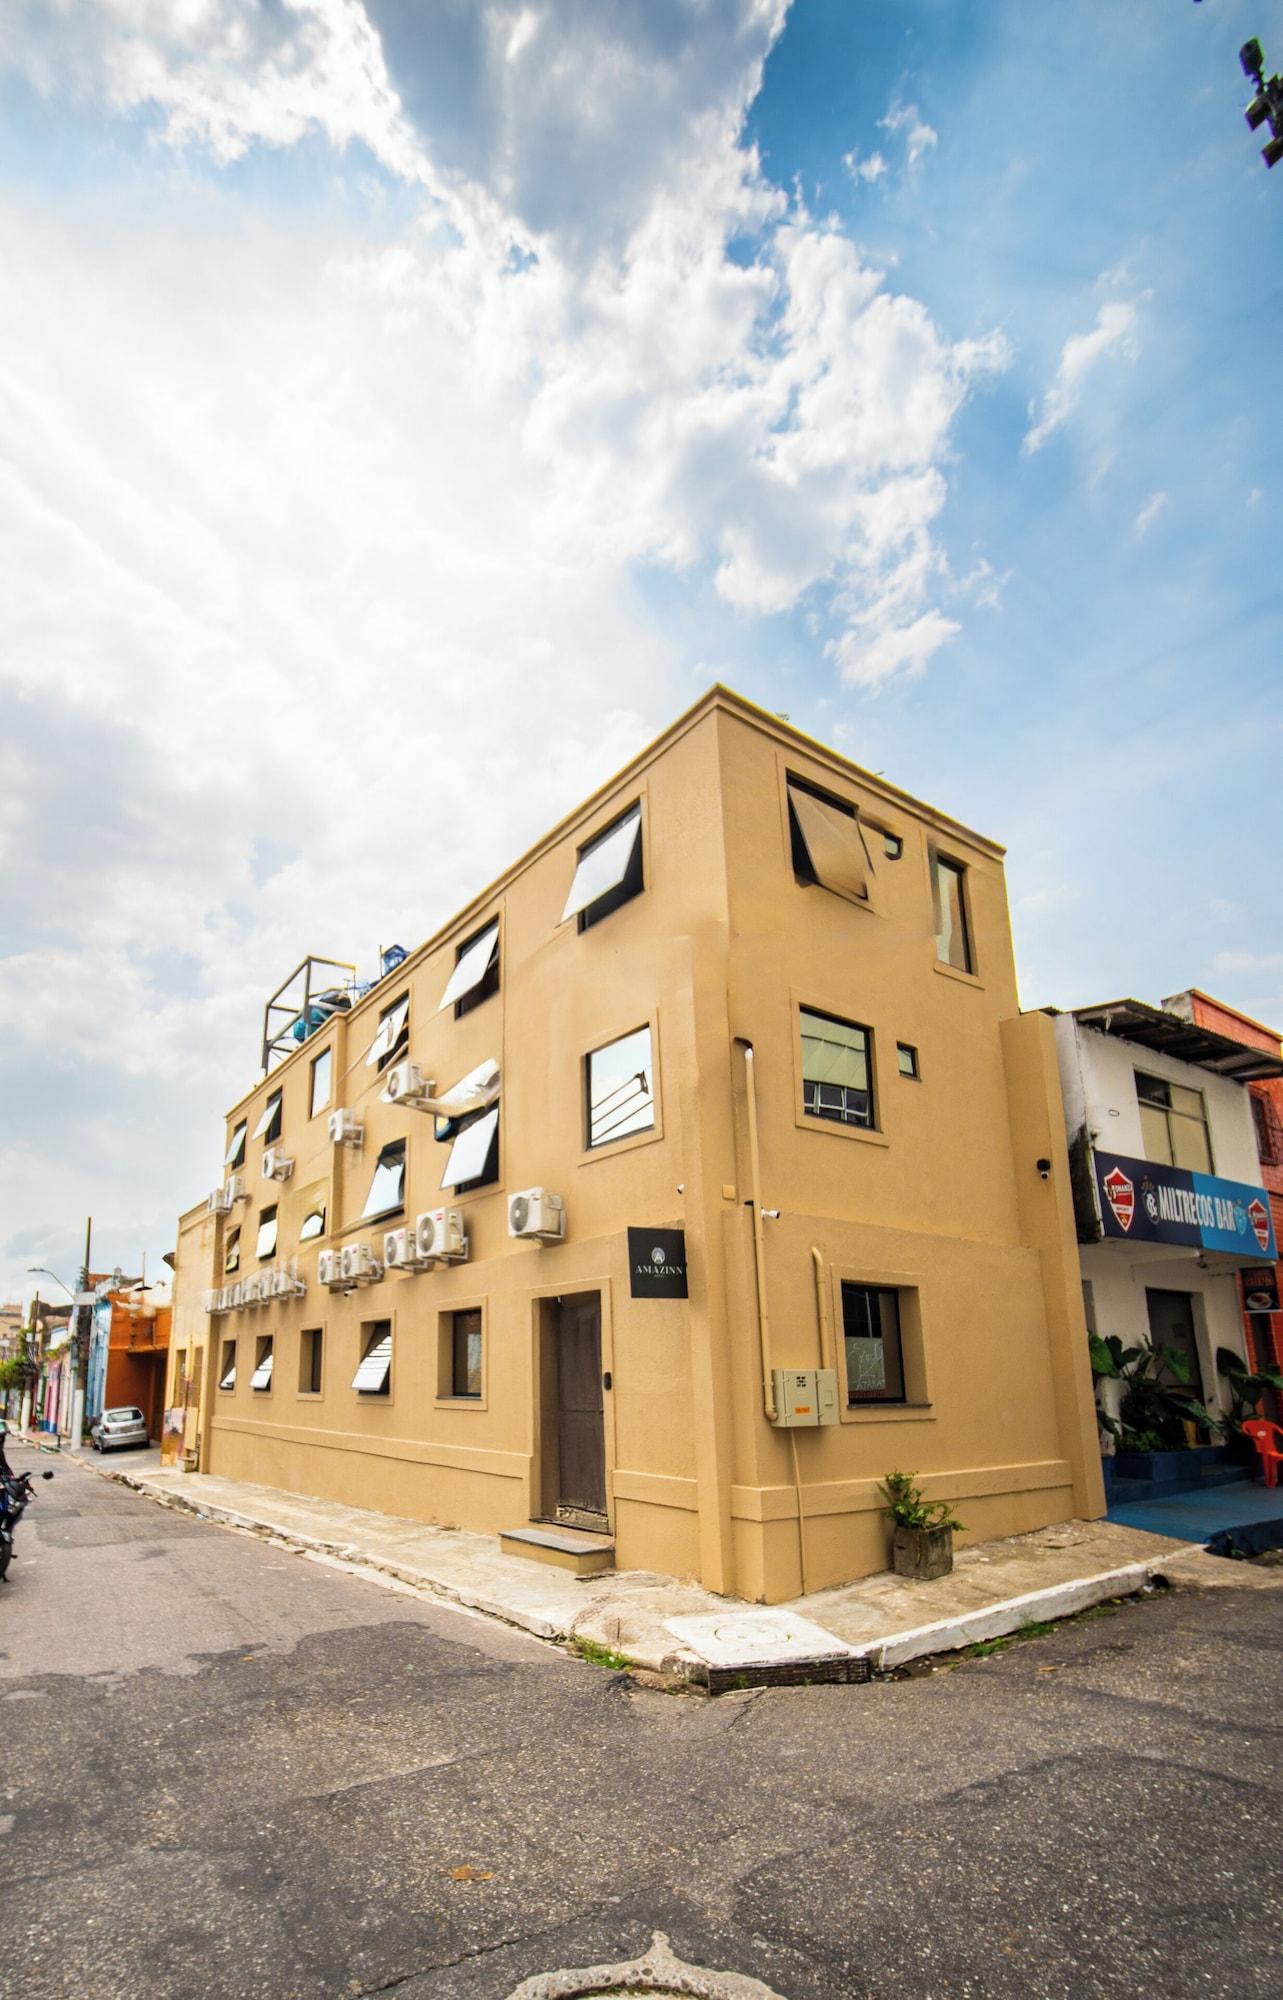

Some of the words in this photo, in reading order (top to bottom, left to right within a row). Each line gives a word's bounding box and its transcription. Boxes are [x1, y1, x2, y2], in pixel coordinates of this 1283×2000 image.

[1158, 1185, 1215, 1228] MILTRECOS
[1215, 1198, 1236, 1231] BAR
[635, 1265, 683, 1275] AMAZINN
